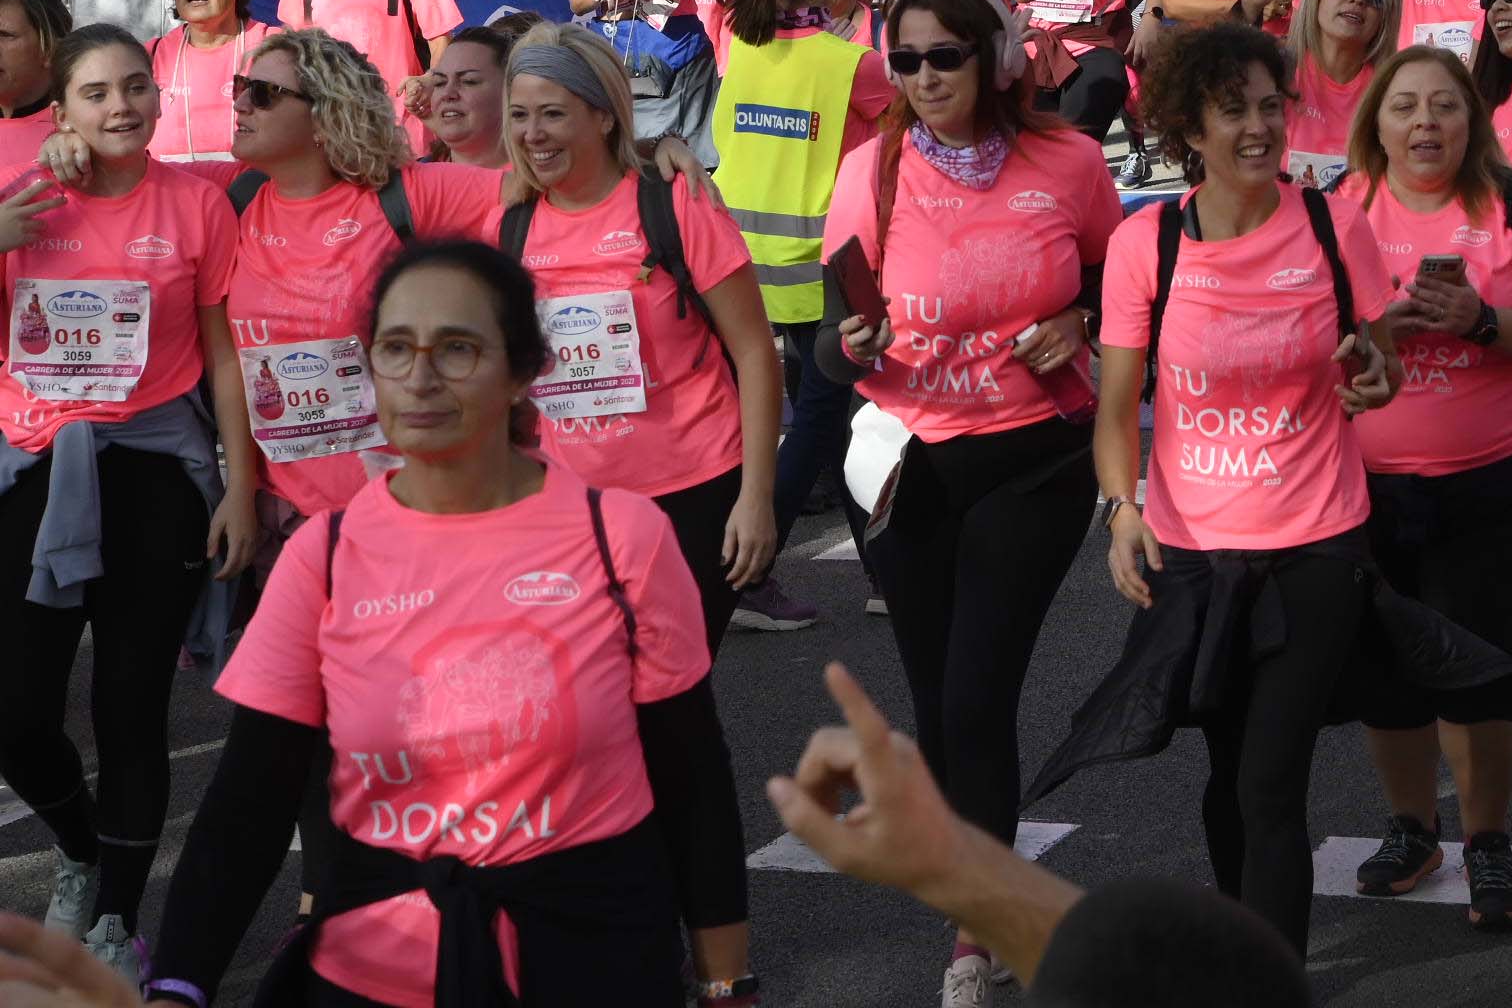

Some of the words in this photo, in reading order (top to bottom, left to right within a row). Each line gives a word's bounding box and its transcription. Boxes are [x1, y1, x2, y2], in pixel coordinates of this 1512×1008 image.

[735, 110, 808, 134] OLUNTARIS
[51, 301, 103, 312] ASTURIANA
[902, 292, 942, 324] TU
[231, 318, 270, 346] TU
[551, 317, 597, 330] ASTURIANA
[54, 328, 102, 345] 016
[62, 350, 92, 362] 3059
[558, 343, 601, 363] 016
[24, 365, 60, 374] CARRERA
[86, 366, 113, 375] MUJER
[281, 363, 325, 376] ASTURIANA
[569, 365, 596, 378] 3057
[536, 384, 571, 395] CARRERA
[572, 383, 583, 391] DE
[583, 382, 593, 390] LA
[593, 379, 619, 388] MUJER
[1169, 363, 1208, 397] TU
[287, 387, 330, 407] 016
[297, 409, 326, 422] 3058
[1176, 403, 1307, 438] DORSAL
[268, 427, 300, 437] CARRERA
[301, 426, 311, 434] DE
[312, 425, 322, 433] LA
[323, 421, 349, 431] MUJER
[1179, 443, 1279, 478] SUMA
[353, 589, 435, 619] OYSHO
[350, 750, 413, 791] TU
[370, 794, 558, 845] DORSAL
